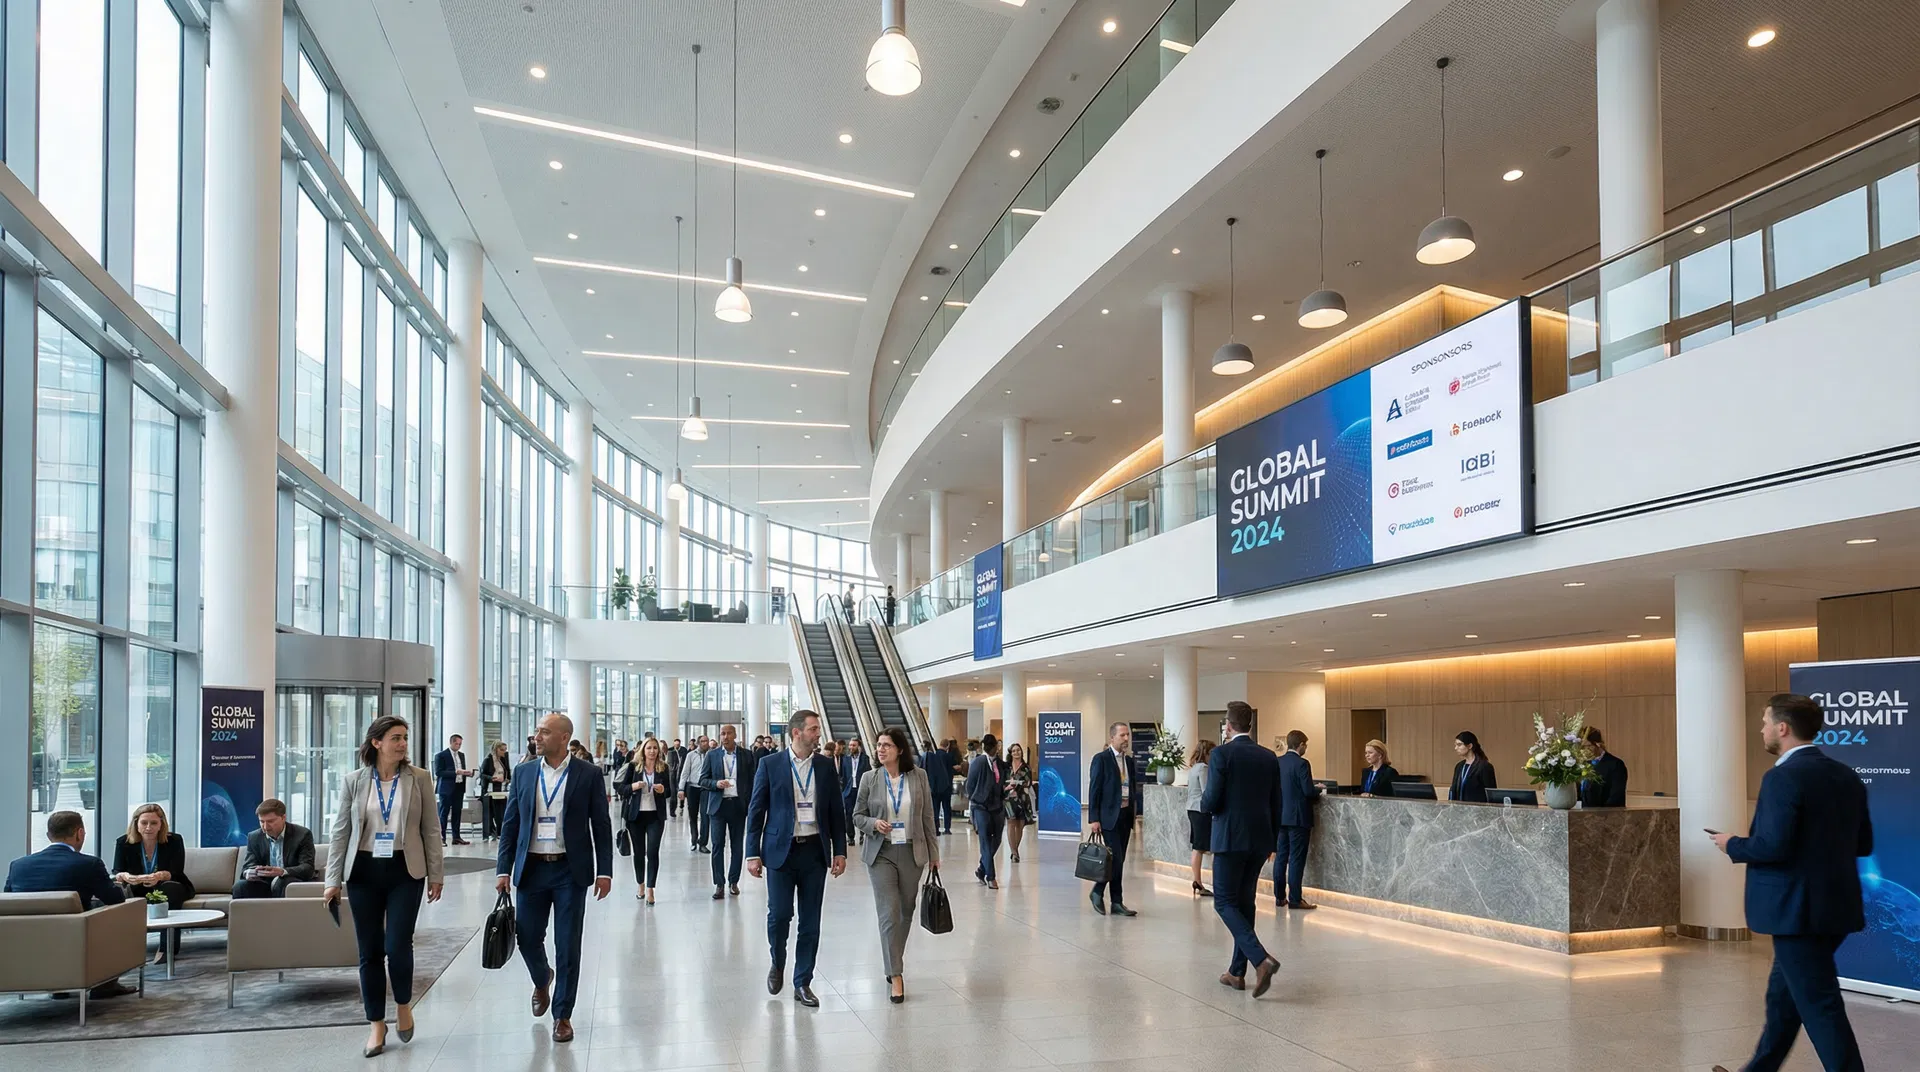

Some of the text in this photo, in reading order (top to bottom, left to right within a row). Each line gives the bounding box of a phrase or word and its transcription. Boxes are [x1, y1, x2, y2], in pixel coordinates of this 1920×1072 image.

[1230, 439, 1326, 495] GLOBAL
[1231, 469, 1326, 525] SUMMIT
[1231, 515, 1285, 554] 2024
[211, 706, 255, 718] GLOBAL
[1823, 709, 1909, 726] UMMIT
[211, 718, 255, 729] SUMMIT
[211, 731, 238, 742] 2024
[1044, 729, 1075, 737] SUMMIT
[1812, 729, 1868, 746] 2024
